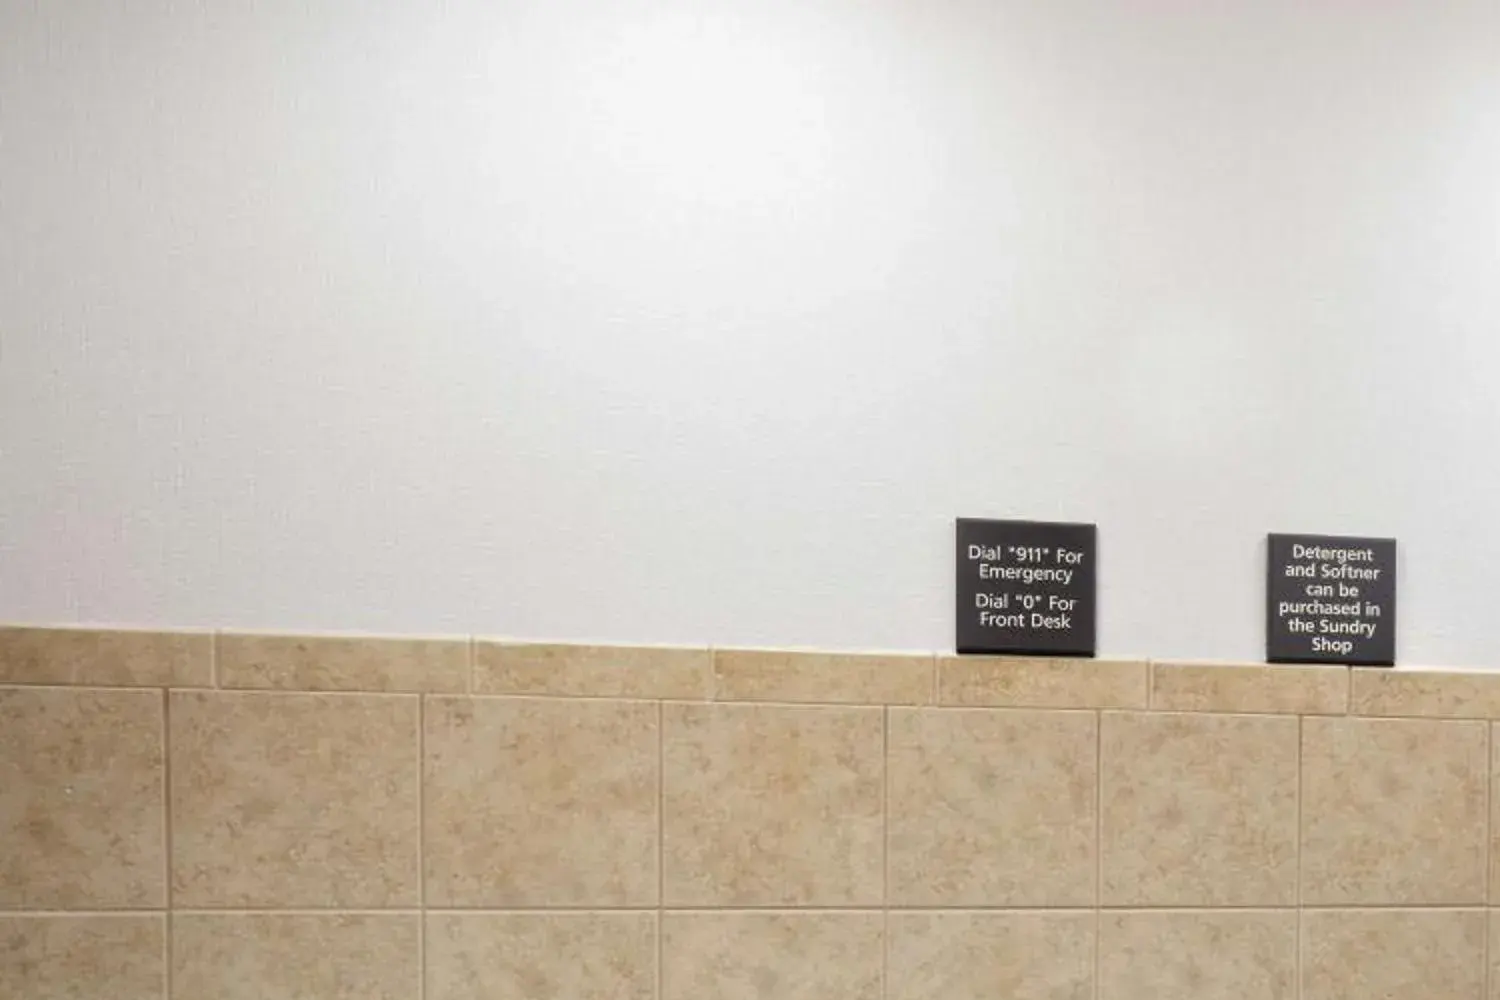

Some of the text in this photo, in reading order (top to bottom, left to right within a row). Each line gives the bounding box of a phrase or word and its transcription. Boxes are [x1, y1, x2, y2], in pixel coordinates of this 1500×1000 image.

[968, 544, 1084, 564] Dial "911" For
[1292, 543, 1375, 565] Detergent
[979, 563, 1073, 585] Emergency
[1284, 563, 1381, 580] and Softner
[1305, 582, 1359, 598] can be
[975, 593, 1008, 609] Dial
[1049, 595, 1077, 611] For
[1279, 599, 1381, 617] purchased in
[980, 611, 1071, 629] Front Desk
[1288, 617, 1377, 639] the Sundry
[1311, 636, 1353, 655] Shop
